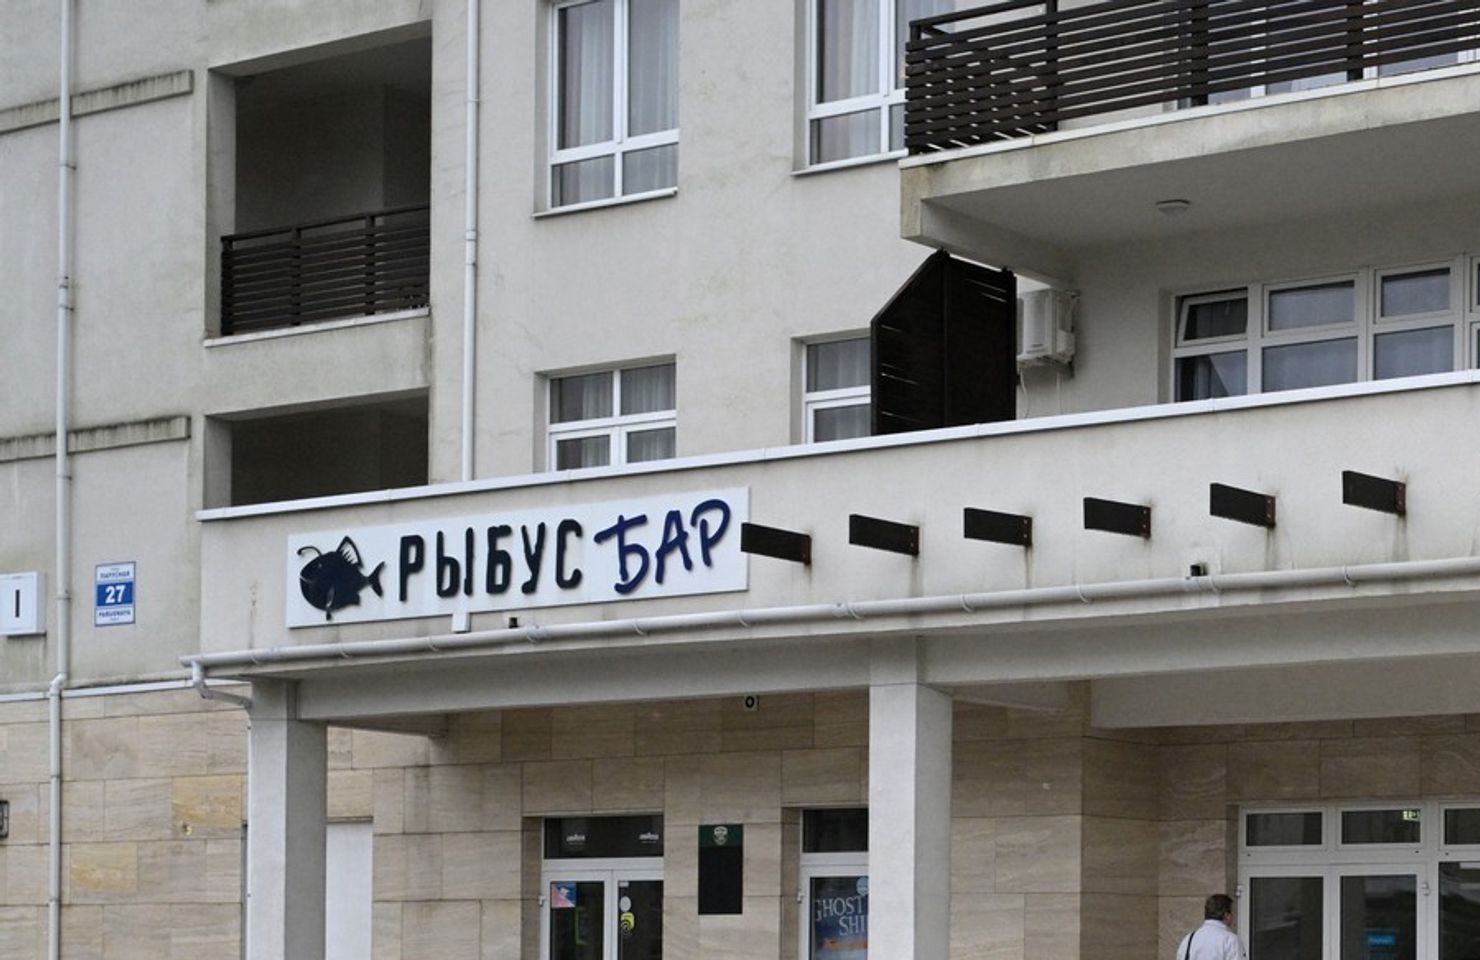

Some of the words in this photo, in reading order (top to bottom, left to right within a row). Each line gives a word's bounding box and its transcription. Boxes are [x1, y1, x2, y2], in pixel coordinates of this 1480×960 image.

[399, 518, 583, 601] РЫБУС
[594, 499, 731, 595] БАР
[105, 584, 125, 603] 27
